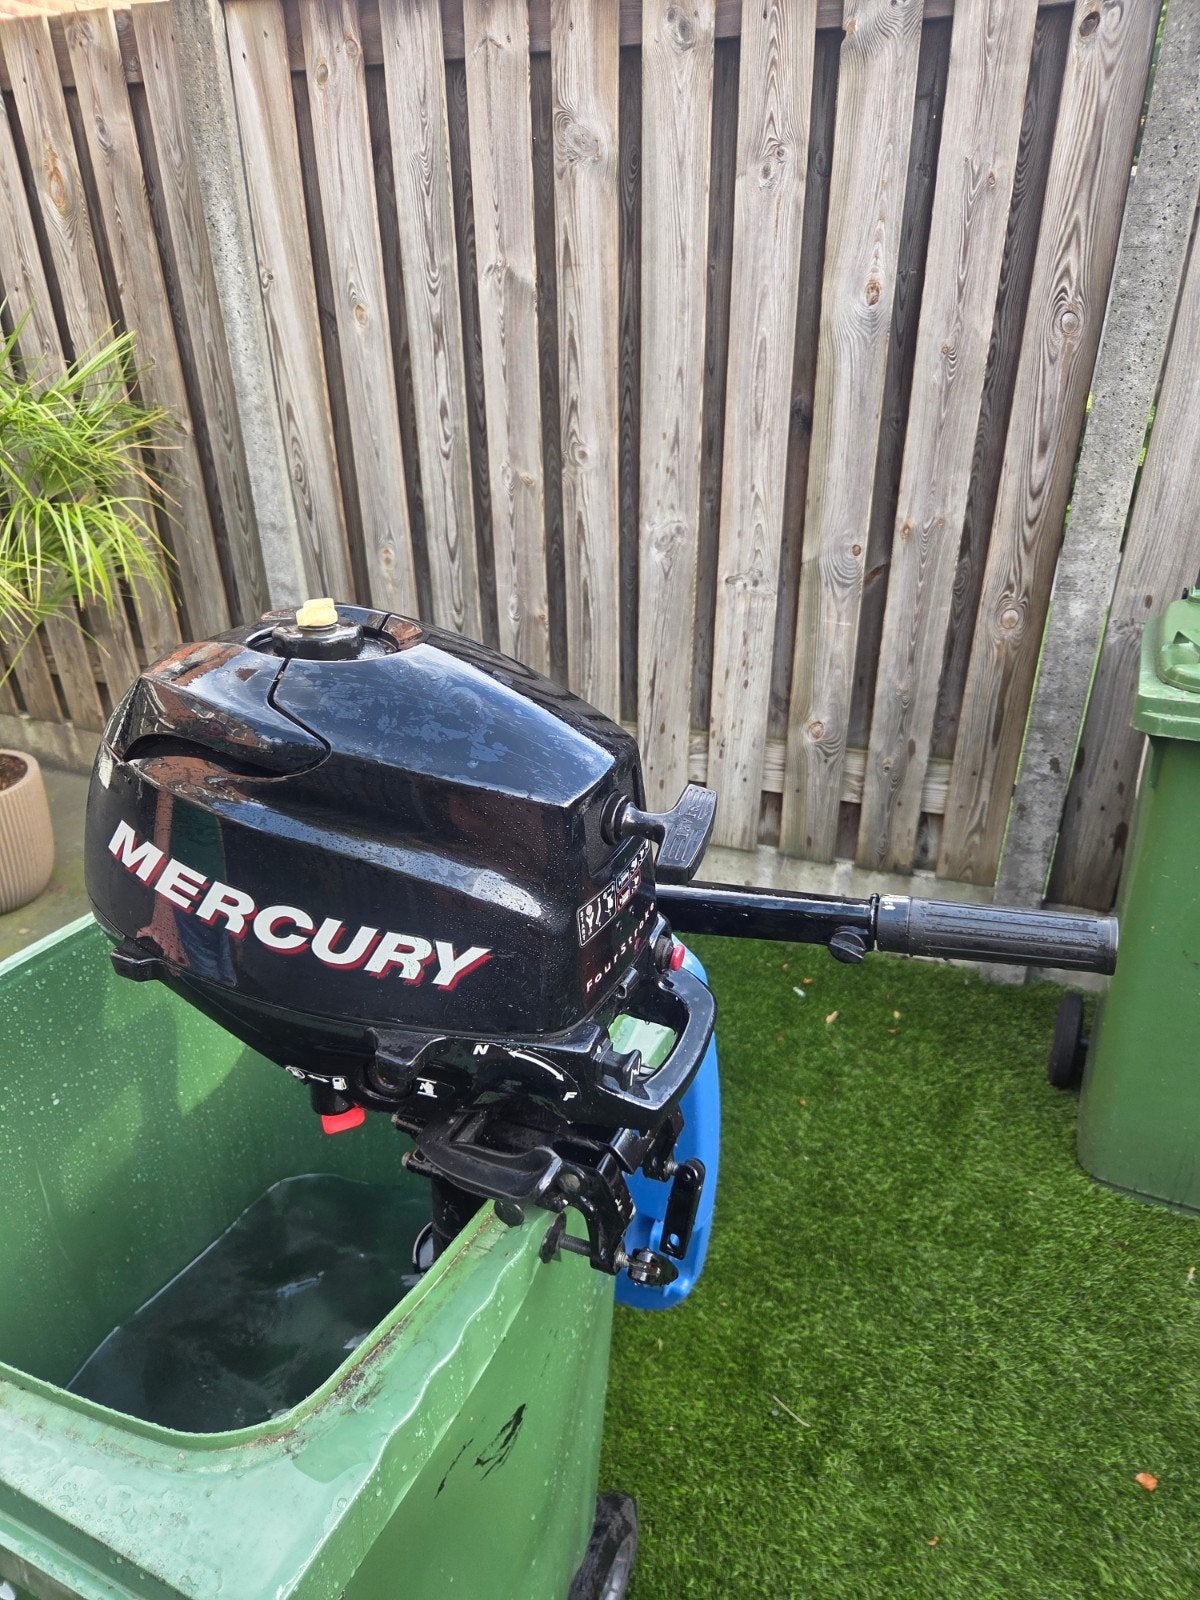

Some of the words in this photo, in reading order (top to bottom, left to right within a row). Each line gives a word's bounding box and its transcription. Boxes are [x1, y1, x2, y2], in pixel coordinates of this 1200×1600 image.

[108, 820, 492, 991] MERCURY
[586, 902, 655, 993] FourStroke
[473, 1044, 489, 1055] N
[563, 1091, 577, 1101] F
